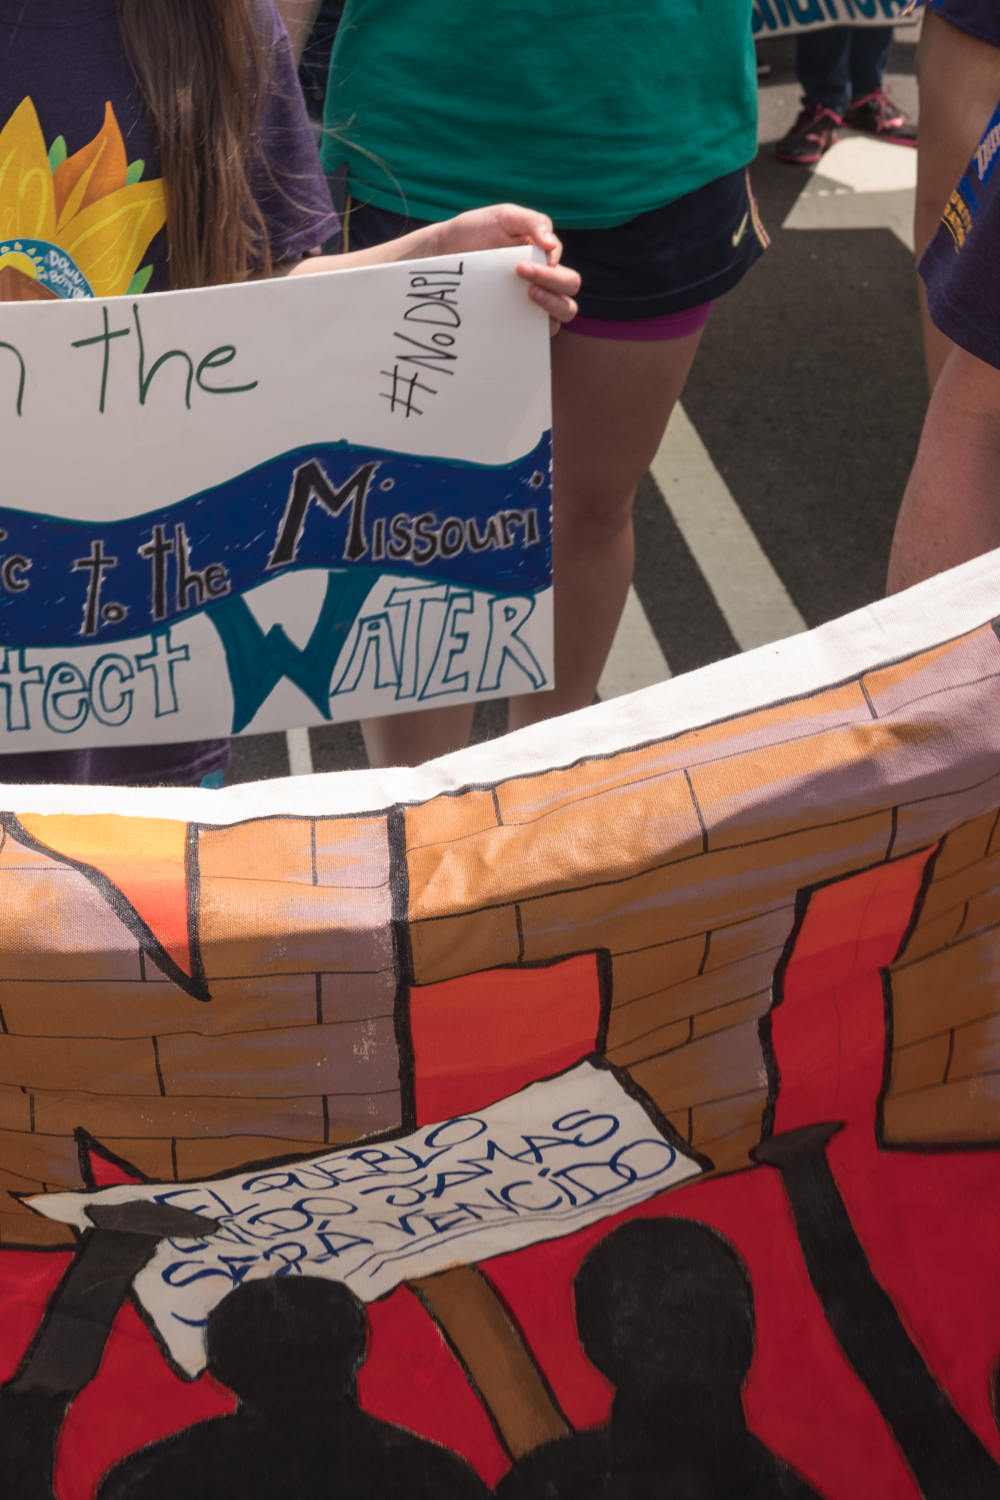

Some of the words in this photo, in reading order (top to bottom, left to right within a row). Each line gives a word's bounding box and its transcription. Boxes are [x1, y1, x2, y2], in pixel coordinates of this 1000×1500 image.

[265, 456, 544, 571] Missouri
[202, 568, 548, 735] WATER
[241, 1117, 488, 1195] PUEBLO
